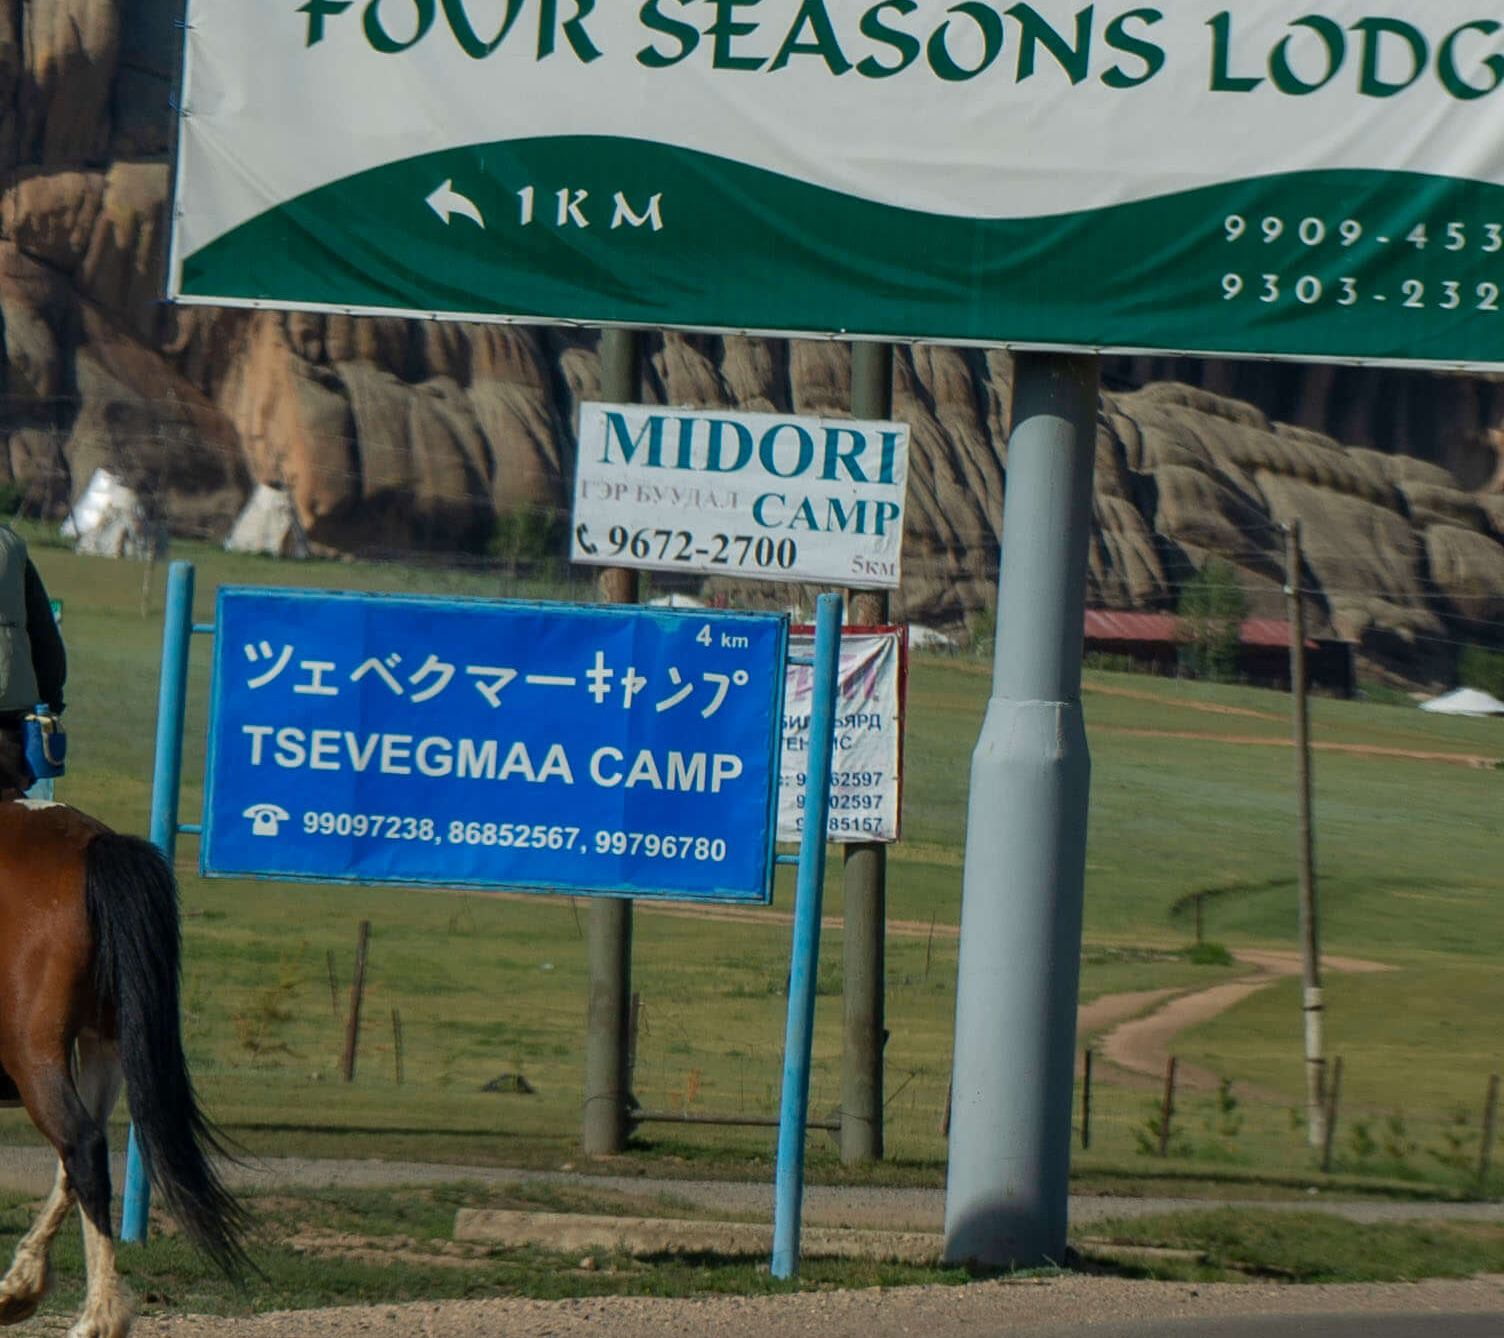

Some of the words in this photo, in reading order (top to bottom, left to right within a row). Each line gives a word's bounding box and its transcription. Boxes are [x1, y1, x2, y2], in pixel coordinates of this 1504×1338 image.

[597, 411, 903, 485] MIDORI
[579, 479, 629, 502] ГЭР
[635, 483, 739, 510] БУУДАЛ
[753, 492, 900, 536] CAMP
[608, 524, 797, 570] 9672-2700
[695, 623, 713, 647] 4
[720, 631, 749, 649] km
[242, 724, 575, 785] TSEVEGMAA
[589, 745, 743, 794] CAMP
[303, 811, 442, 846] 99097238,
[448, 822, 587, 855] 86852567,
[594, 830, 726, 863] 99796780
